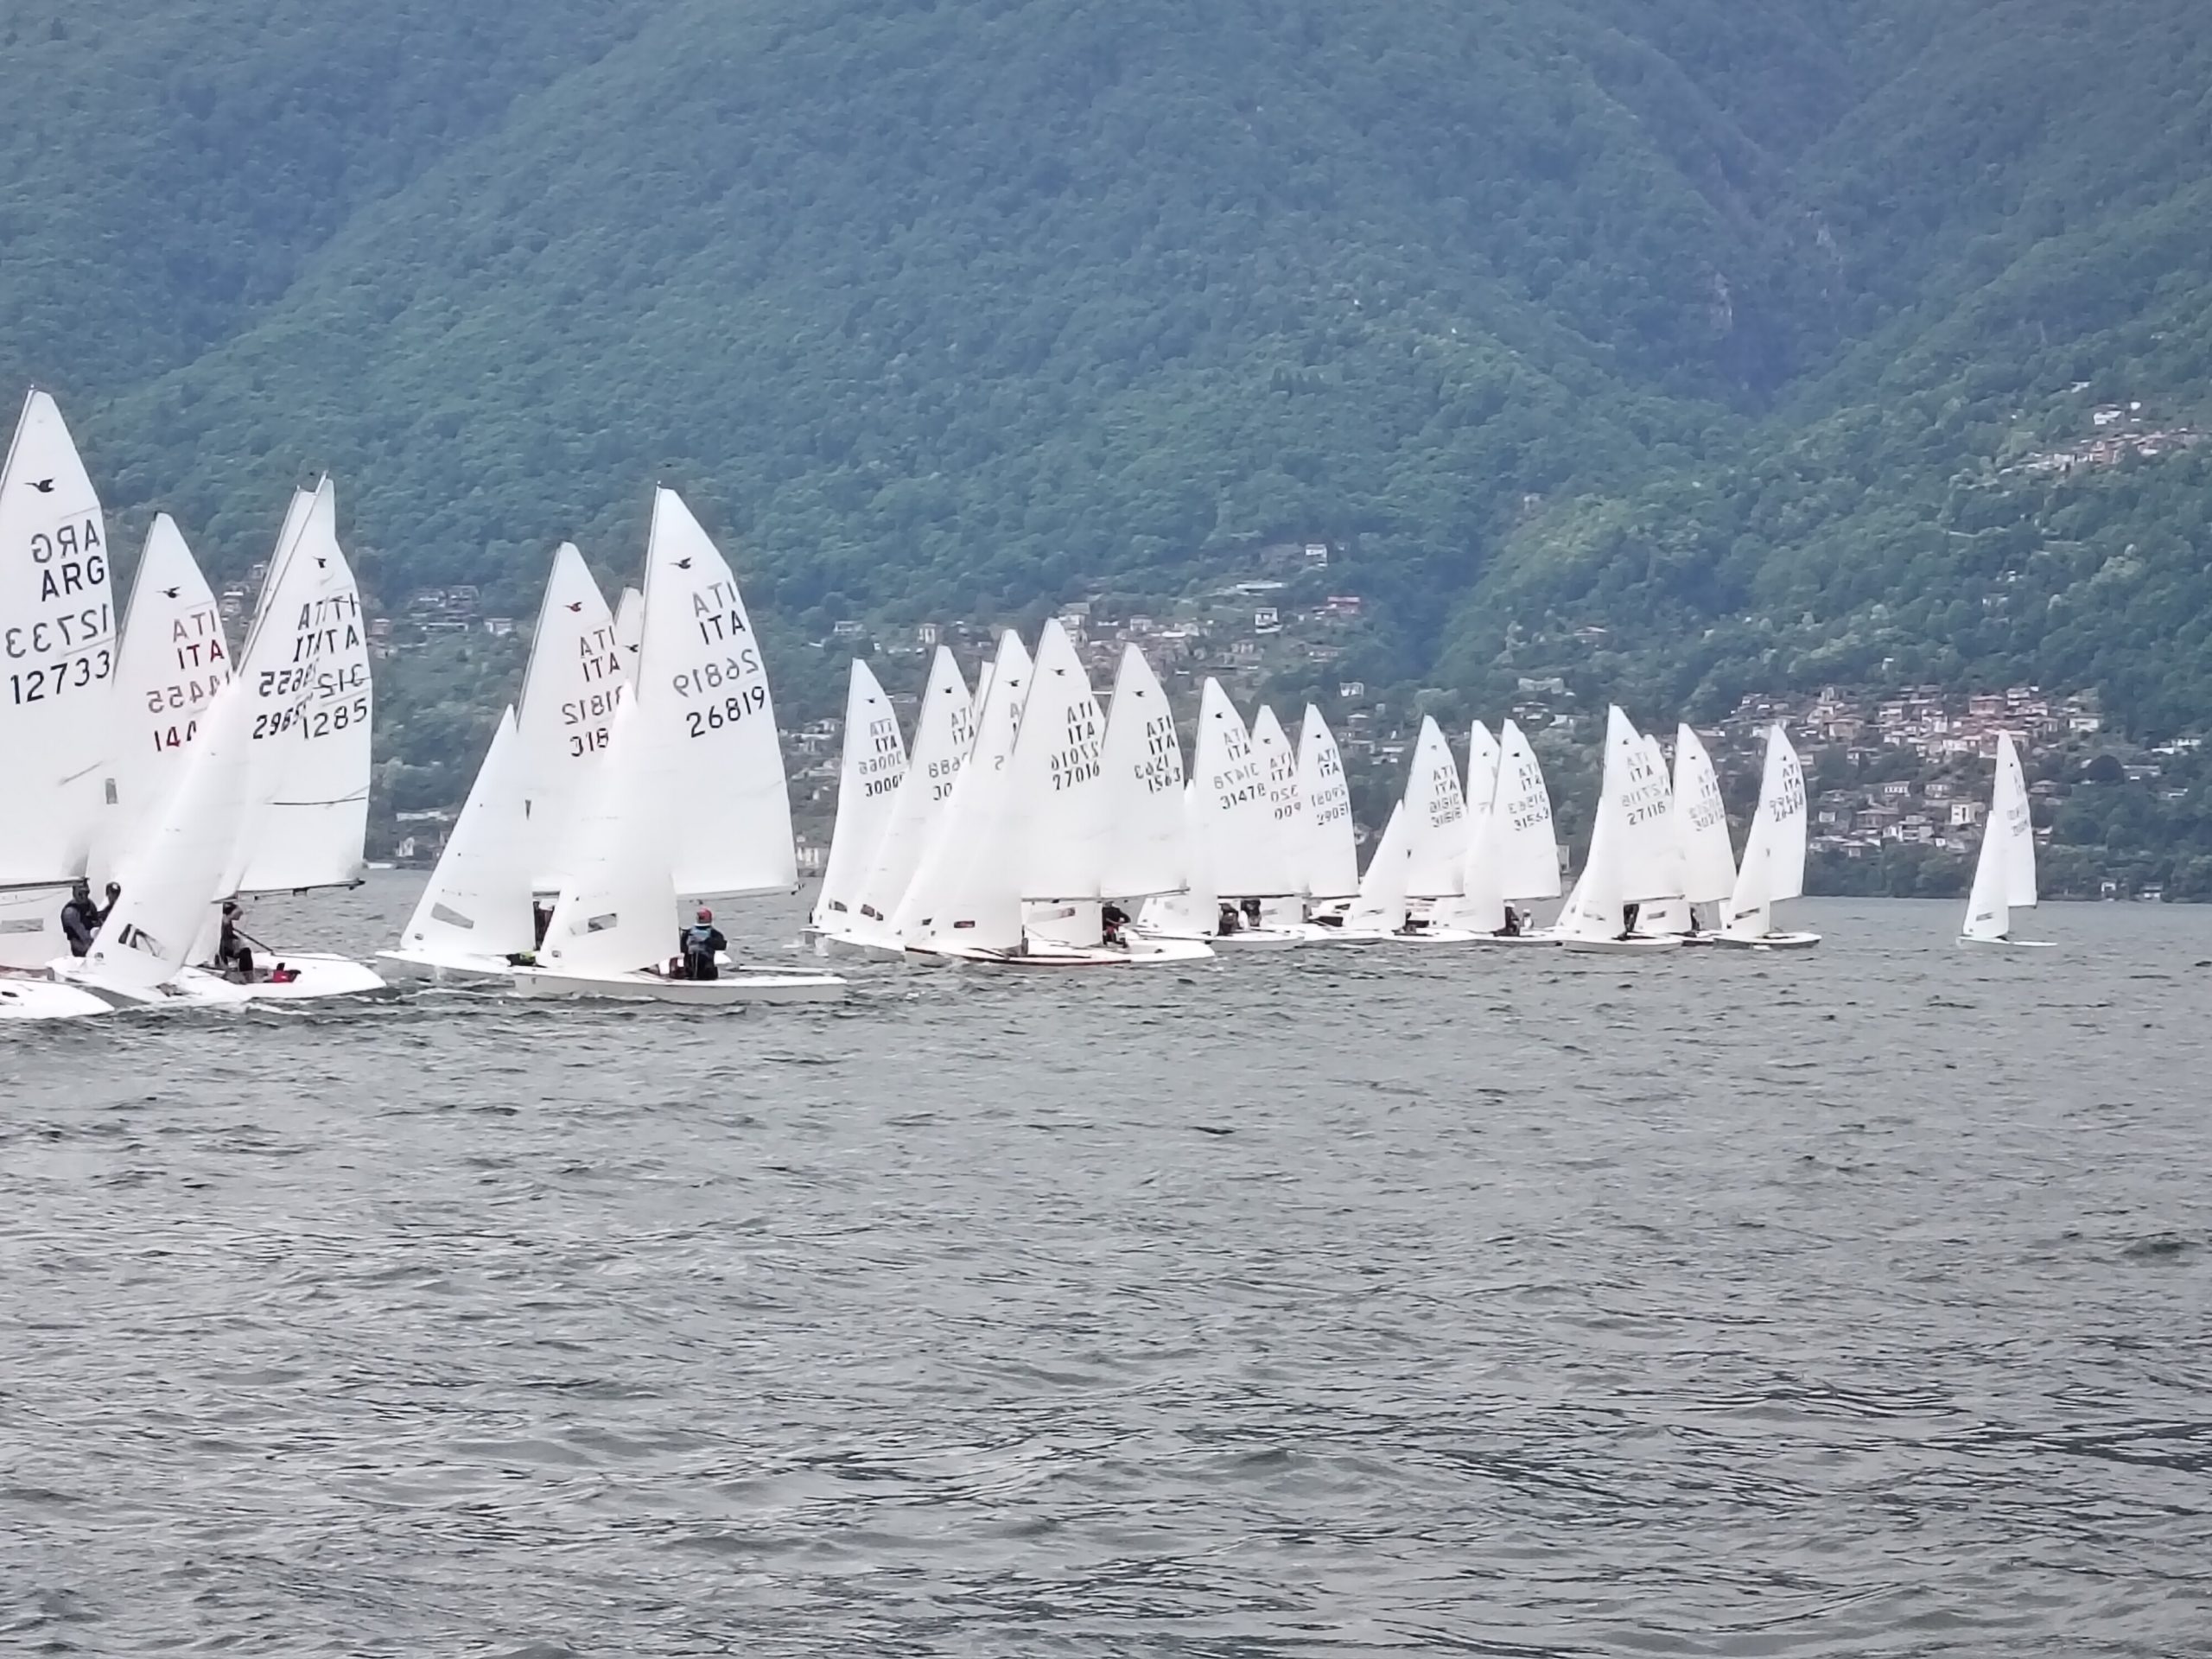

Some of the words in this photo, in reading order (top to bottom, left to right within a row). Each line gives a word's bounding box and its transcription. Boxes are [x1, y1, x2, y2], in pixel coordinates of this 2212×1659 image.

[41, 556, 105, 601] ARG
[699, 610, 746, 645] ITA
[177, 639, 225, 670] ITA
[582, 652, 620, 683] ITA
[10, 650, 111, 705] 12733
[686, 686, 765, 738] 26819
[875, 734, 898, 753] ITA
[952, 725, 974, 745] ITA
[1068, 721, 1095, 745] ITA
[1148, 734, 1175, 755] ITA
[1228, 742, 1250, 761] ITA
